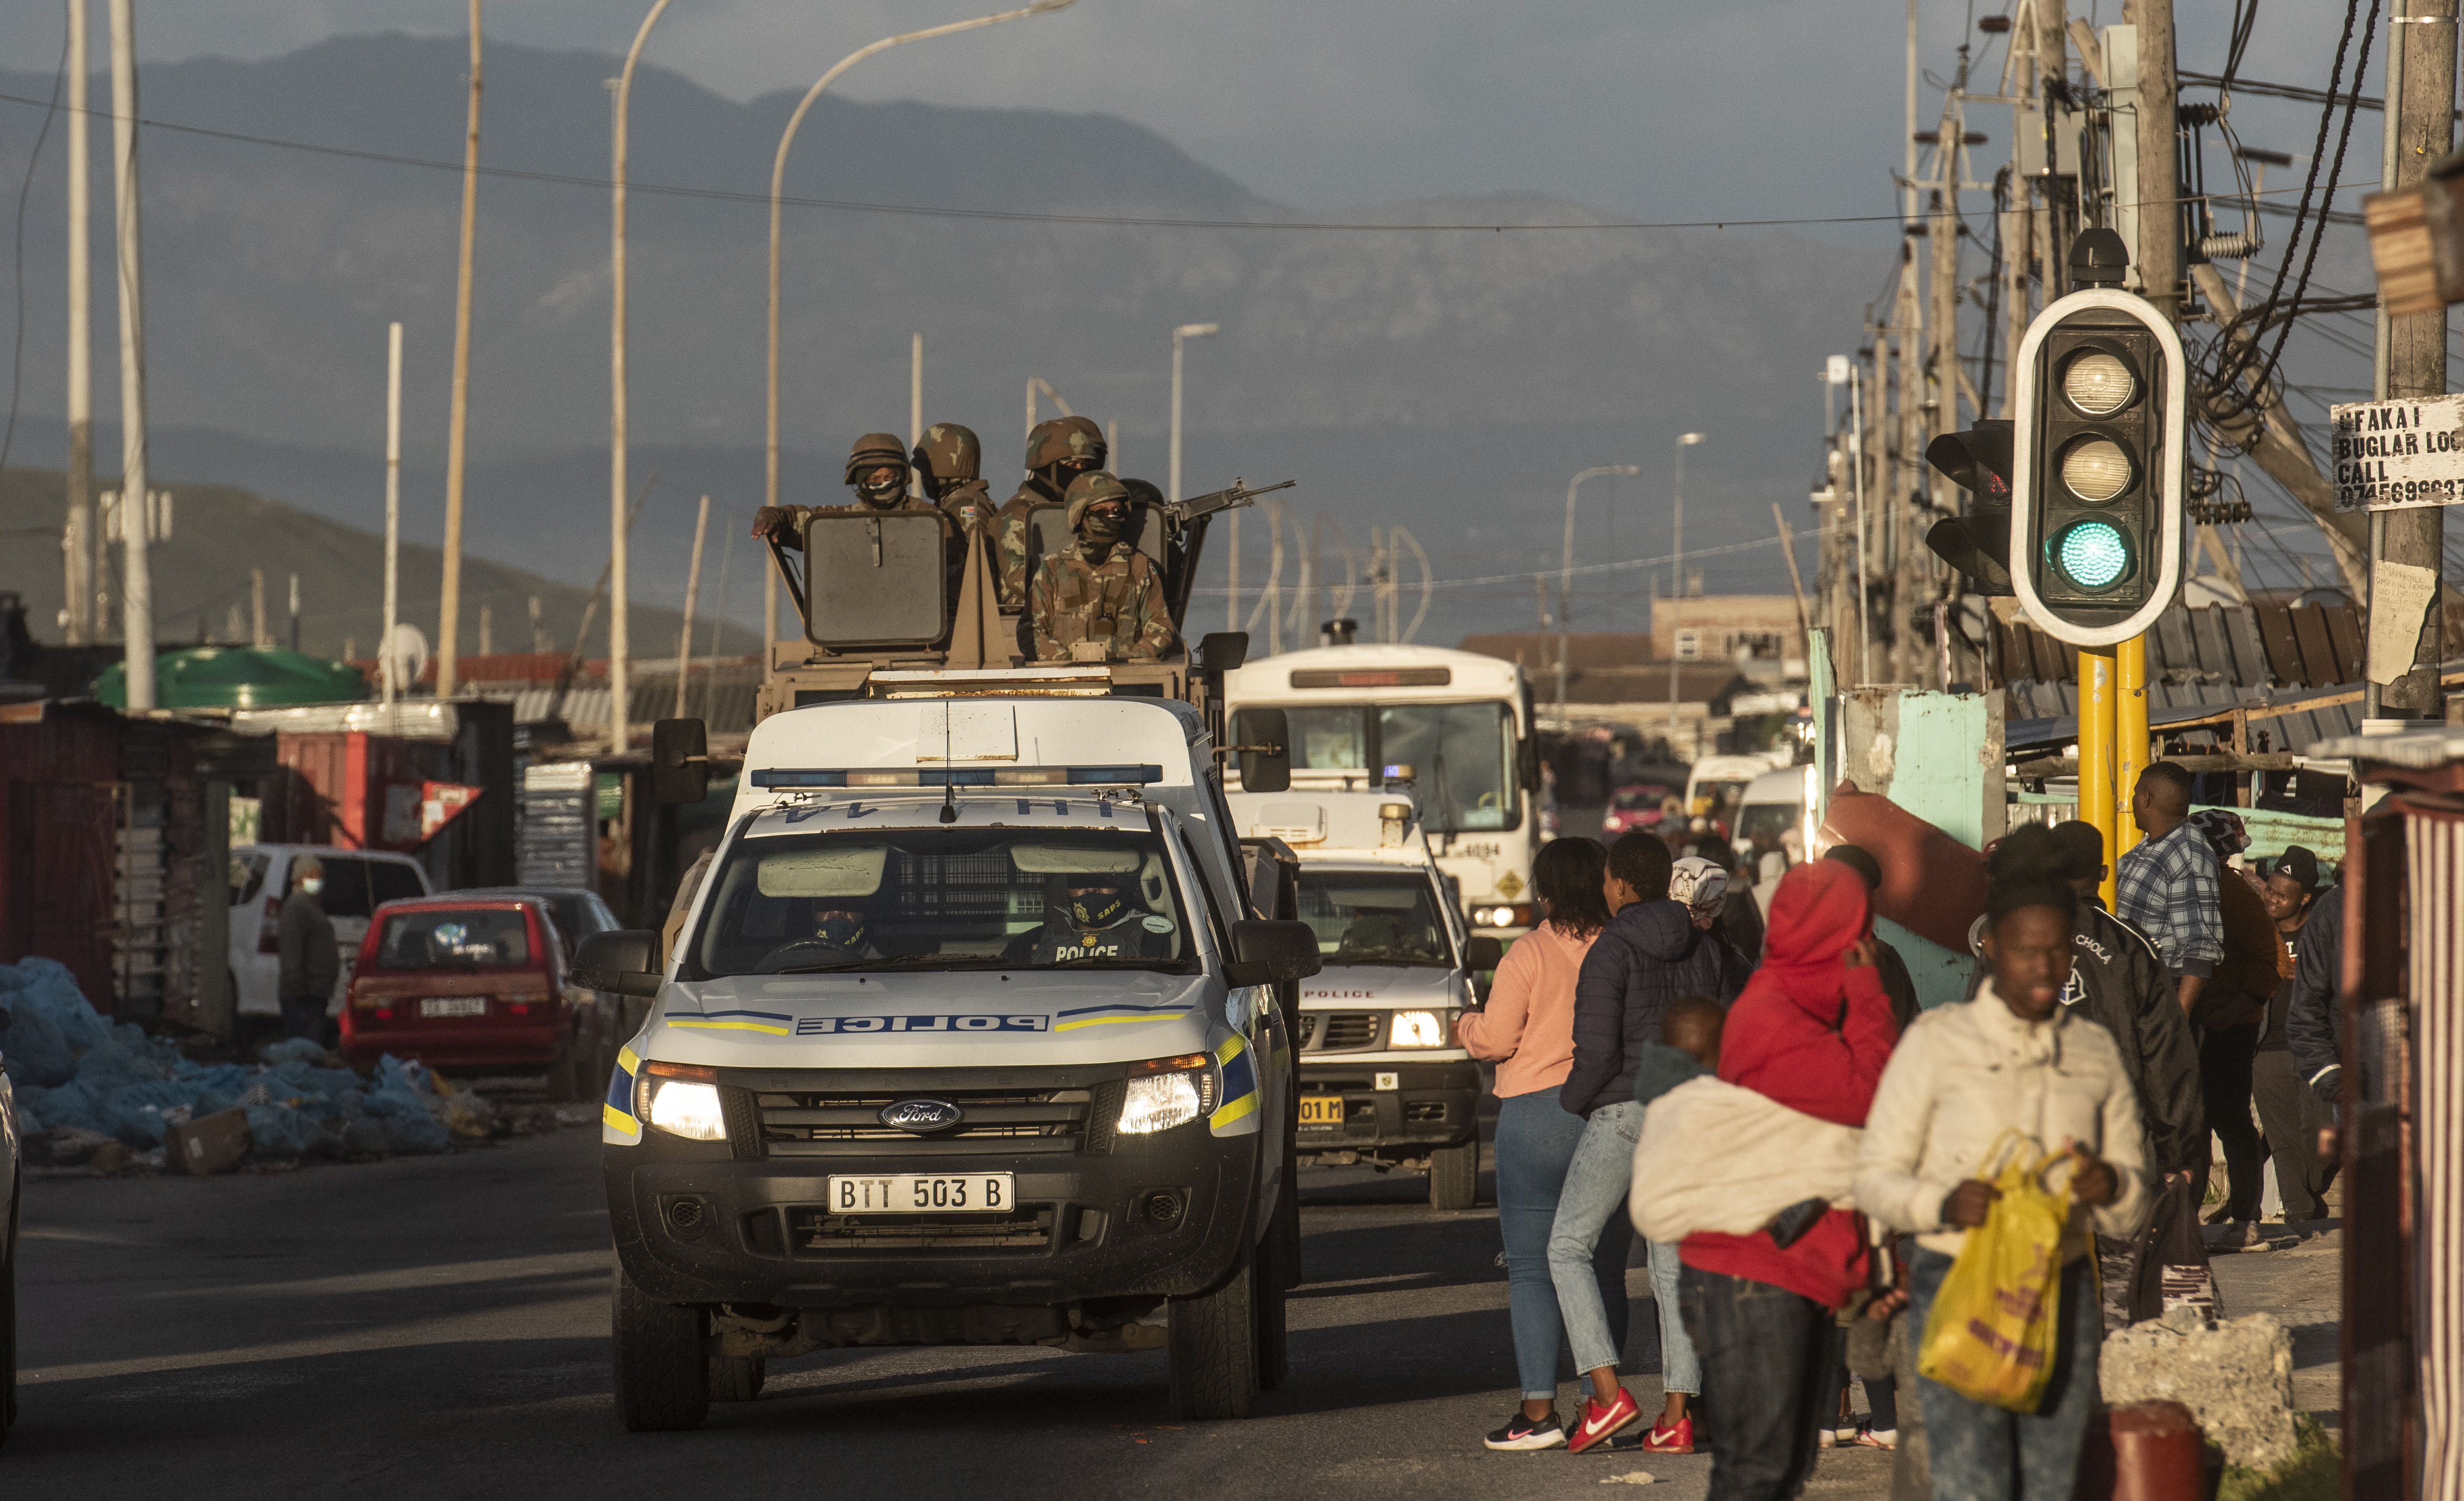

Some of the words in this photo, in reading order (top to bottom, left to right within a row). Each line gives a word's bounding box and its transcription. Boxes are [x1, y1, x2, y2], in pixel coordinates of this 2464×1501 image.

[2338, 433, 2419, 459] BUGLAR
[2338, 461, 2388, 484] CALL
[1097, 899, 1121, 919] SAPS
[1056, 945, 1118, 961] POLICE
[1304, 990, 1375, 999] POLICE
[898, 1104, 942, 1122] Ford
[1301, 1101, 1322, 1120] 01
[1328, 1101, 1341, 1119] M
[841, 1179, 893, 1208] BTT
[914, 1179, 967, 1207] 503
[986, 1179, 1001, 1207] B
